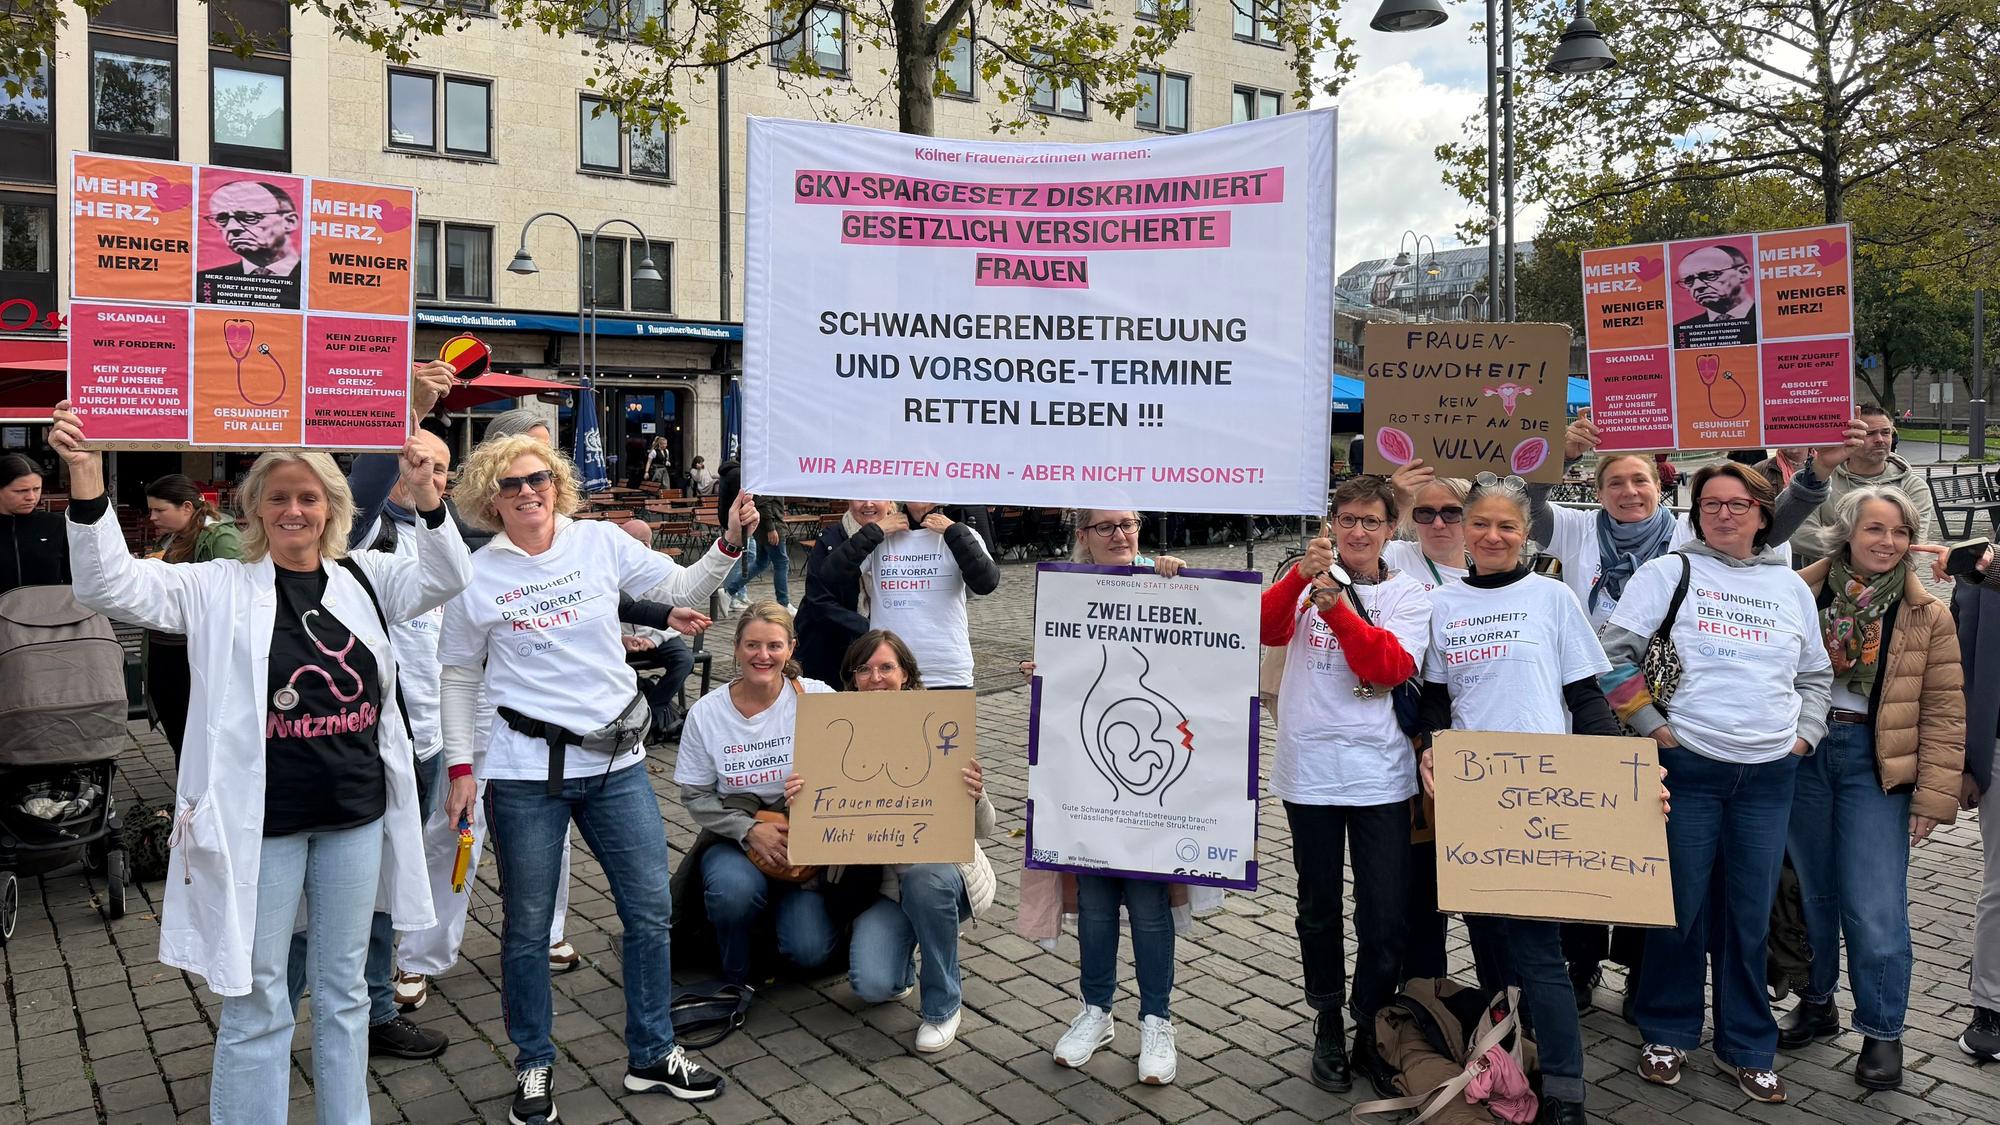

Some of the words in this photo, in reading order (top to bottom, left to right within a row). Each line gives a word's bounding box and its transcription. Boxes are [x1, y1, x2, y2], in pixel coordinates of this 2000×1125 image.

[915, 147, 961, 163] Kölner
[1091, 148, 1151, 161] warnen:
[76, 175, 159, 198] MEHR
[796, 172, 1038, 207] GKV-SPARGESETZ
[1046, 173, 1267, 207] DISKRIMINIERT
[75, 200, 160, 225] HERZ,
[312, 198, 382, 219] MEHR
[311, 221, 382, 244] HERZ,
[843, 214, 1008, 244] GESETZLICH
[1015, 215, 1216, 245] VERSICHERTE
[97, 234, 189, 253] WENIGER
[329, 252, 407, 271] WENIGER
[1760, 245, 1821, 262] MEHR
[98, 254, 159, 271] MERZ!
[977, 256, 1087, 283] FRAUEN
[1585, 261, 1641, 277] MEHR
[329, 271, 381, 287] MERZ!
[1760, 264, 1822, 280] HERZ,
[1586, 279, 1642, 294] HERZ,
[1776, 285, 1846, 301] WENIGER
[1601, 300, 1664, 314] WENIGER
[1778, 302, 1823, 316] MERZ!
[97, 312, 166, 324] SKANDAL!
[1602, 316, 1644, 328] MERZ!
[818, 311, 1247, 343] SCHWANGERENBETREUUNG
[118, 340, 176, 349] FORDERN:
[326, 333, 350, 341] KEIN
[354, 334, 398, 343] ZUGRIFF
[1407, 331, 1515, 350] FRAUEN-
[325, 343, 346, 351] AUF
[349, 344, 366, 352] DIE
[368, 345, 390, 353] ePA!
[1801, 352, 1840, 360] ZUGRIFF
[1606, 354, 1655, 363] SKANDAL!
[93, 365, 119, 373] KEIN
[122, 366, 168, 375] ZUGRIFF
[328, 367, 383, 377] ABSOLUTE
[834, 353, 900, 379] UND
[908, 356, 1233, 385] VORSORGE-TERMINE
[1367, 361, 1531, 379] GESUNDHEIT
[121, 376, 164, 385] UNSERE
[338, 378, 376, 386] GRENZ-
[1781, 380, 1828, 389] ABSOLUTE
[81, 386, 178, 395] TERMINKALENDER
[307, 386, 406, 398] ÜBERSCHREITUNG!
[1438, 395, 1479, 408] KEIN
[91, 407, 188, 416] KRANKENKASSEN!
[213, 407, 289, 418] GESUNDHEIT
[315, 409, 331, 417] WIR
[333, 409, 367, 418] WOLLEN
[370, 410, 395, 418] KEINE
[903, 397, 1021, 425] RETTEN
[1030, 401, 1128, 427] LEBEN
[1138, 403, 1164, 428] !!!
[1599, 408, 1667, 417] TERMINKALENDER
[224, 420, 248, 431] FÜR
[251, 421, 283, 431] ALLE!
[305, 416, 405, 428] ÜBERWACHUNGSSTAAT!
[1389, 413, 1478, 425] ROTSTIFT
[1486, 417, 1510, 428] AN
[1520, 418, 1549, 432] DIE
[1692, 420, 1750, 429] GESUNDHEIT
[1700, 430, 1718, 438] FÜR
[1720, 430, 1746, 438] ALLE!
[1432, 436, 1505, 463] VULVA
[798, 456, 836, 475] WIR
[841, 458, 940, 478] ARBEITEN
[945, 461, 1000, 480] GERN
[1021, 464, 1076, 482] ABER
[1081, 465, 1146, 483] NICHT
[1151, 466, 1264, 485] UMSONST!
[881, 553, 942, 562] GESUNDHEIT?
[880, 568, 898, 576] DER
[901, 568, 938, 576] VORRAT
[880, 580, 930, 590] REICHT!
[1096, 579, 1141, 588] VERSORGEN
[1143, 581, 1167, 589] STATT
[1169, 583, 1199, 591] SPAREN
[530, 590, 583, 614] VORRAT
[1696, 588, 1779, 611] GESUNDHEIT?
[511, 609, 579, 631] REICHT!
[1086, 601, 1132, 621] ZWEI
[1136, 603, 1203, 626] LEBEN.
[1445, 612, 1528, 630] GESUNDHEIT?
[1697, 606, 1724, 618] DER
[1726, 611, 1776, 628] VORRAT
[411, 620, 428, 630] BVF
[1698, 620, 1768, 643] REICHT!
[1045, 621, 1082, 639] EINE
[1086, 624, 1246, 650] VERANTWORTUNG.
[1445, 636, 1467, 646] DER
[1470, 630, 1520, 643] VORRAT
[535, 641, 553, 651] BVF
[1718, 647, 1737, 658] BVF
[1446, 645, 1507, 665] REICHT!
[1464, 675, 1480, 684] BVF
[723, 735, 791, 754] GESUNDHEIT?
[724, 761, 745, 772] DER
[748, 753, 790, 768] VORRAT
[726, 769, 783, 787] REICHT!
[1497, 786, 1618, 810] STERBEN
[1062, 803, 1079, 812] Gute
[1081, 805, 1187, 823] Schwangerschaftsbetreuung
[1188, 815, 1217, 825] braucht
[1069, 812, 1114, 822] verlässliche
[1115, 815, 1165, 828] fachärztliche
[1166, 821, 1208, 832] Strukturen.
[867, 828, 905, 847] wichtig
[1207, 846, 1238, 862] BVF
